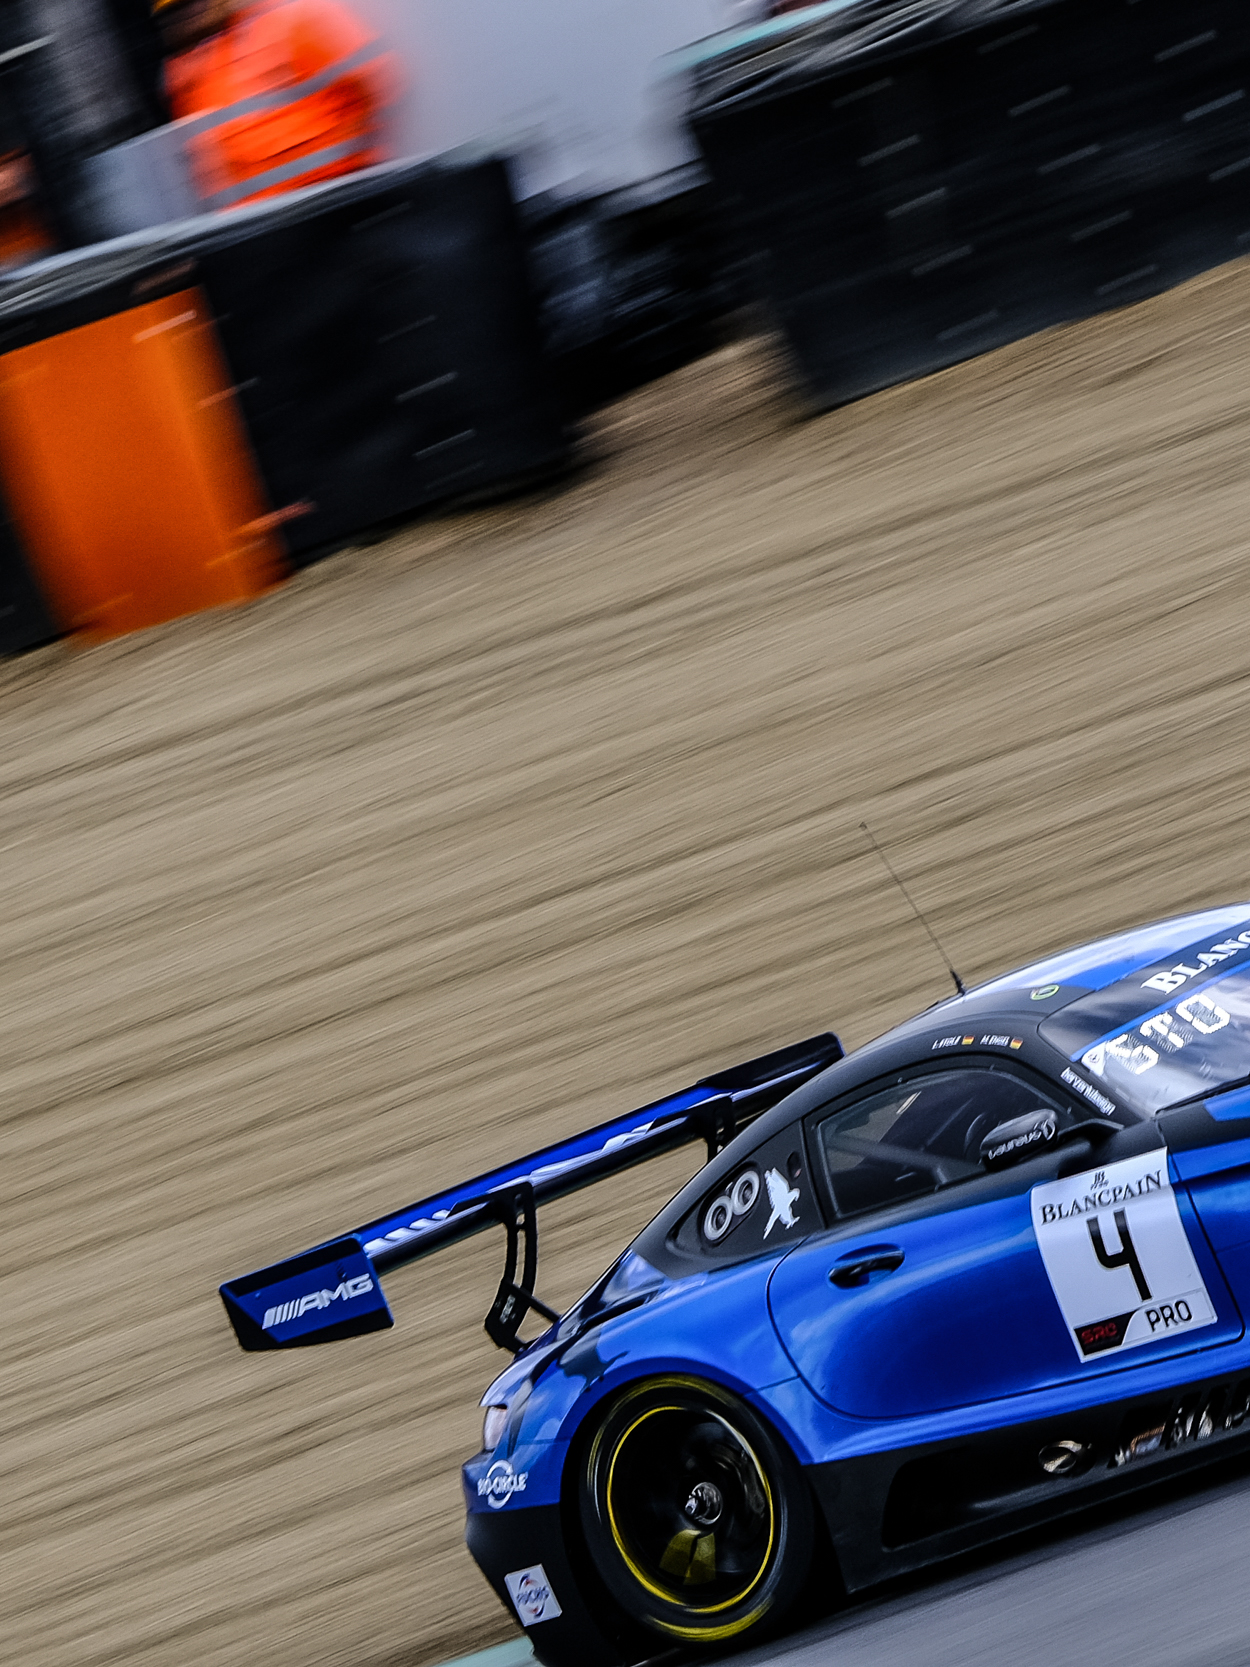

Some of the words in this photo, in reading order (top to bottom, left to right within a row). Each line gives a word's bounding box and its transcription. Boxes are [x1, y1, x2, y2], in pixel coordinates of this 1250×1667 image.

[1039, 1169, 1162, 1225] BLANCPAIN
[1086, 1207, 1152, 1302] 4
[297, 1273, 374, 1318] AMG
[1145, 1300, 1192, 1332] PRO
